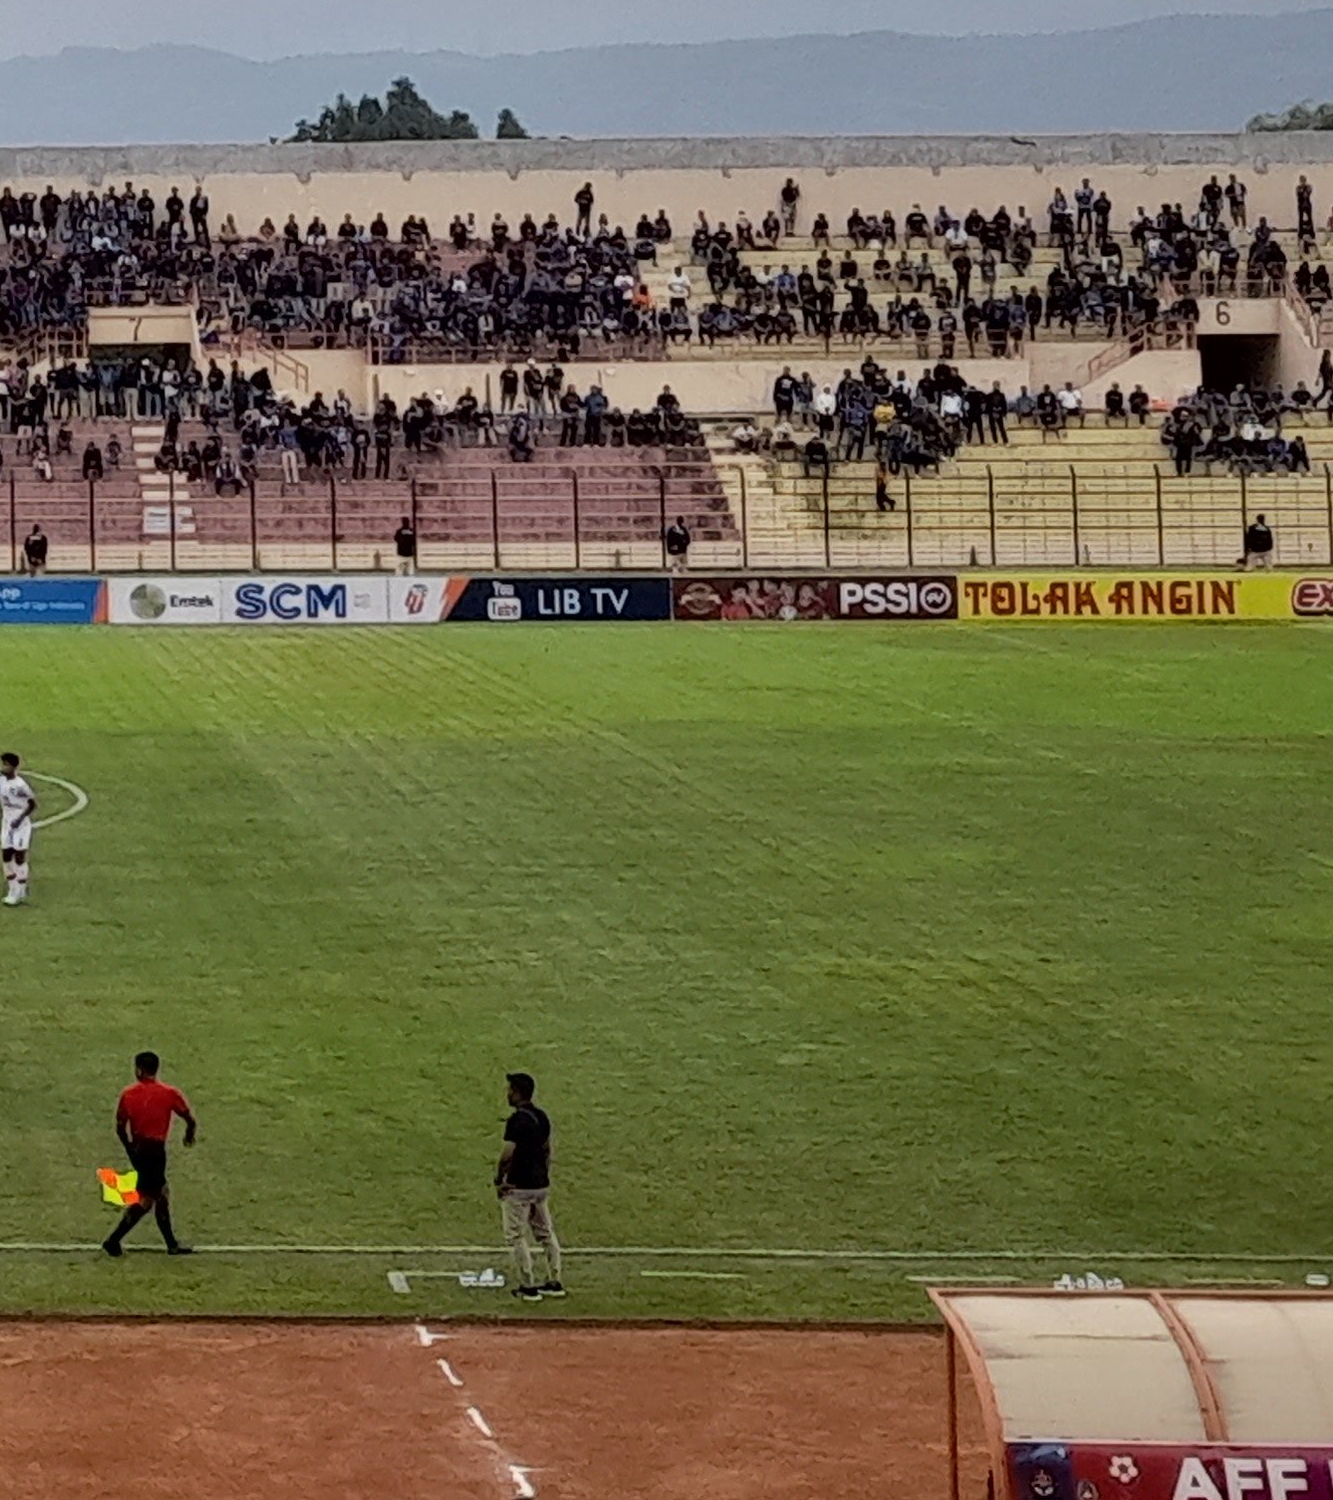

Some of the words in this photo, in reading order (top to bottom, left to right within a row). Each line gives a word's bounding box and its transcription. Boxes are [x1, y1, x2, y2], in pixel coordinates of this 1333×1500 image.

[1216, 301, 1231, 326] 6
[234, 582, 347, 620] SCM
[537, 587, 582, 615] LIB
[589, 587, 629, 615] TV
[839, 582, 918, 614] PSSI
[964, 580, 1104, 616] TOLAK
[1108, 580, 1236, 615] ANGIN
[1171, 1457, 1309, 1500] AFF
